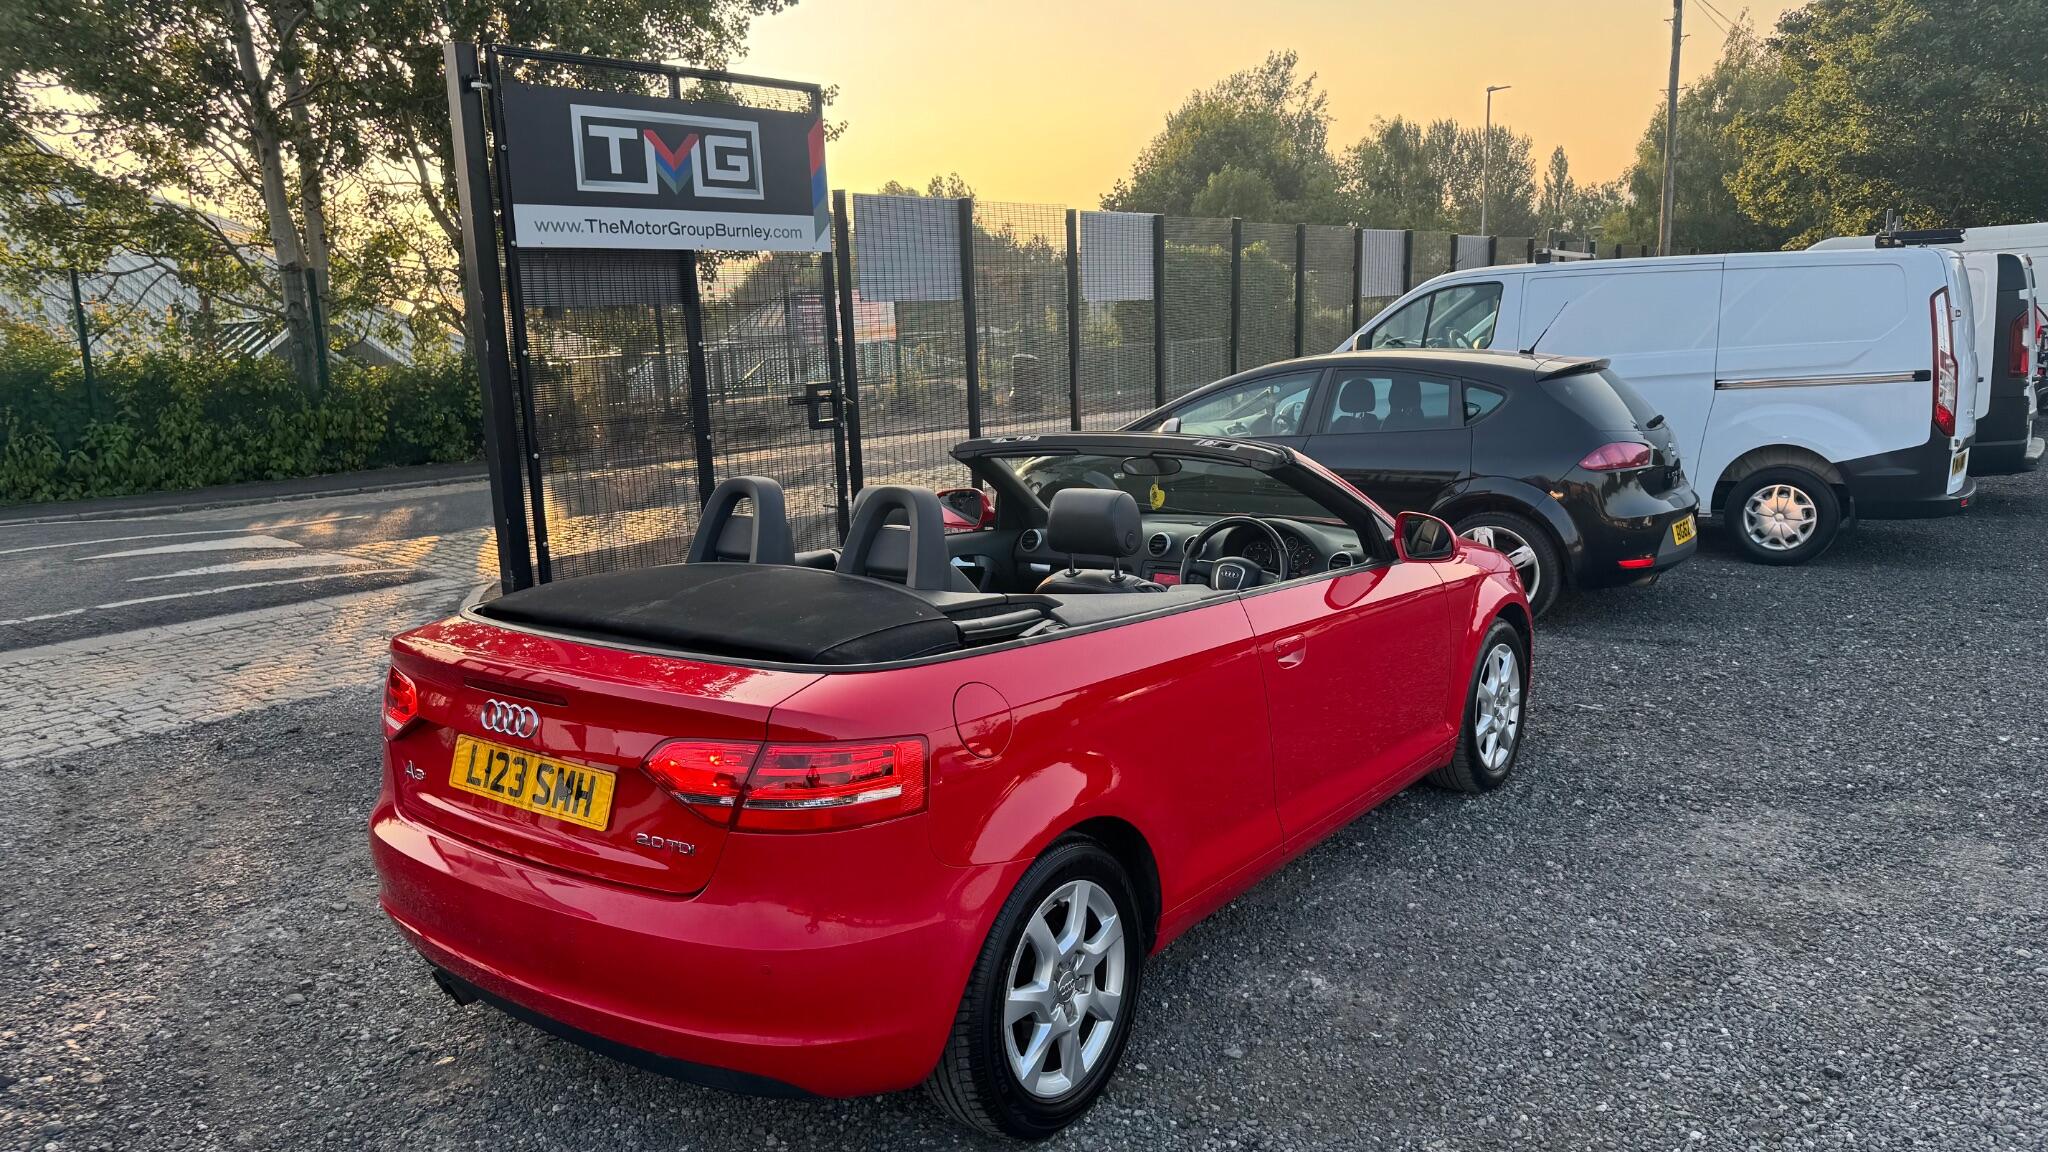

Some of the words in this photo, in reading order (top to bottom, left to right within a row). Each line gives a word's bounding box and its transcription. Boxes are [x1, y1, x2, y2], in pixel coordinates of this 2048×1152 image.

[588, 124, 750, 197] TMG
[534, 218, 803, 241] www.TheMotorGroupBurnley.com
[466, 744, 527, 798] L123
[532, 764, 596, 818] SMH
